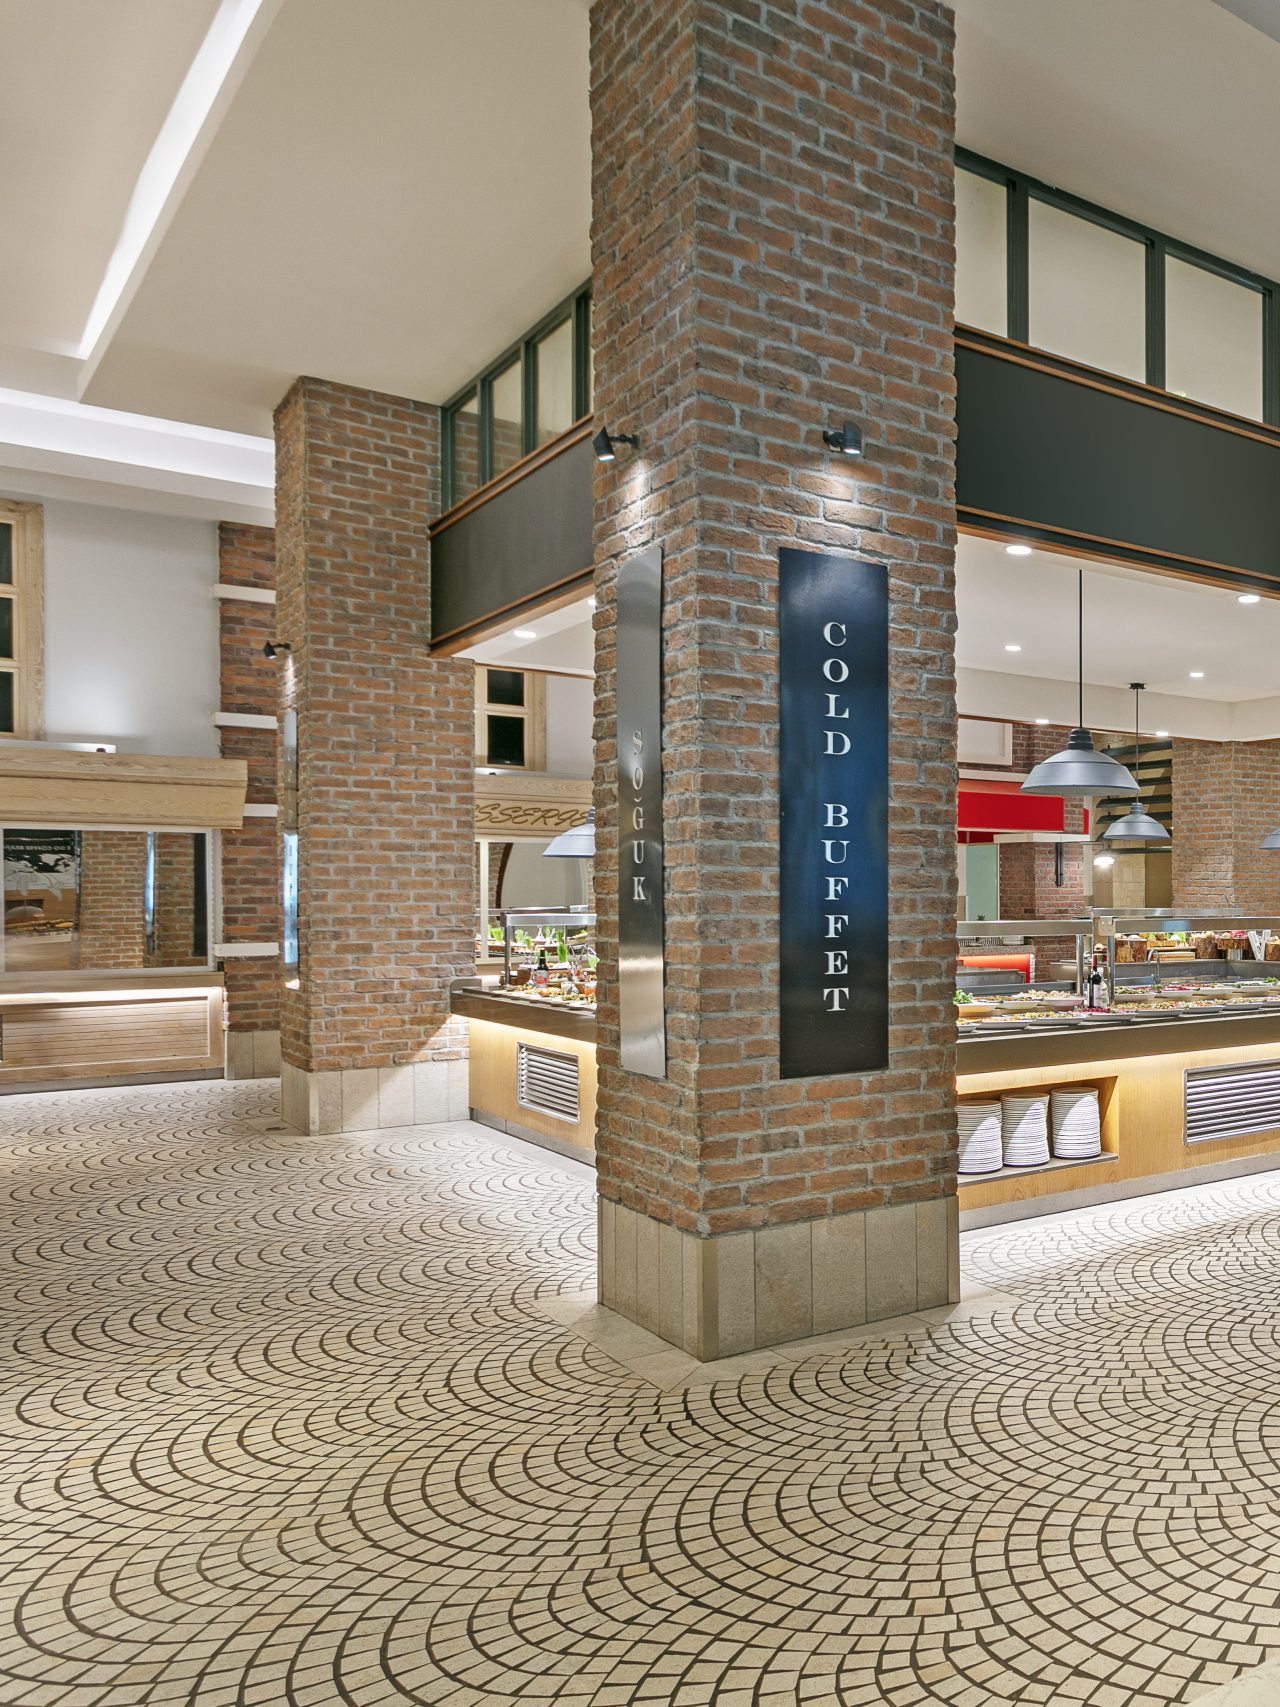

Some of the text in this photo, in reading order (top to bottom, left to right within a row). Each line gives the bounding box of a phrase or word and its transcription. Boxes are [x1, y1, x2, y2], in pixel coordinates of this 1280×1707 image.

[632, 730, 646, 900] SOĞUK
[821, 621, 851, 1012] COLD BUFFET
